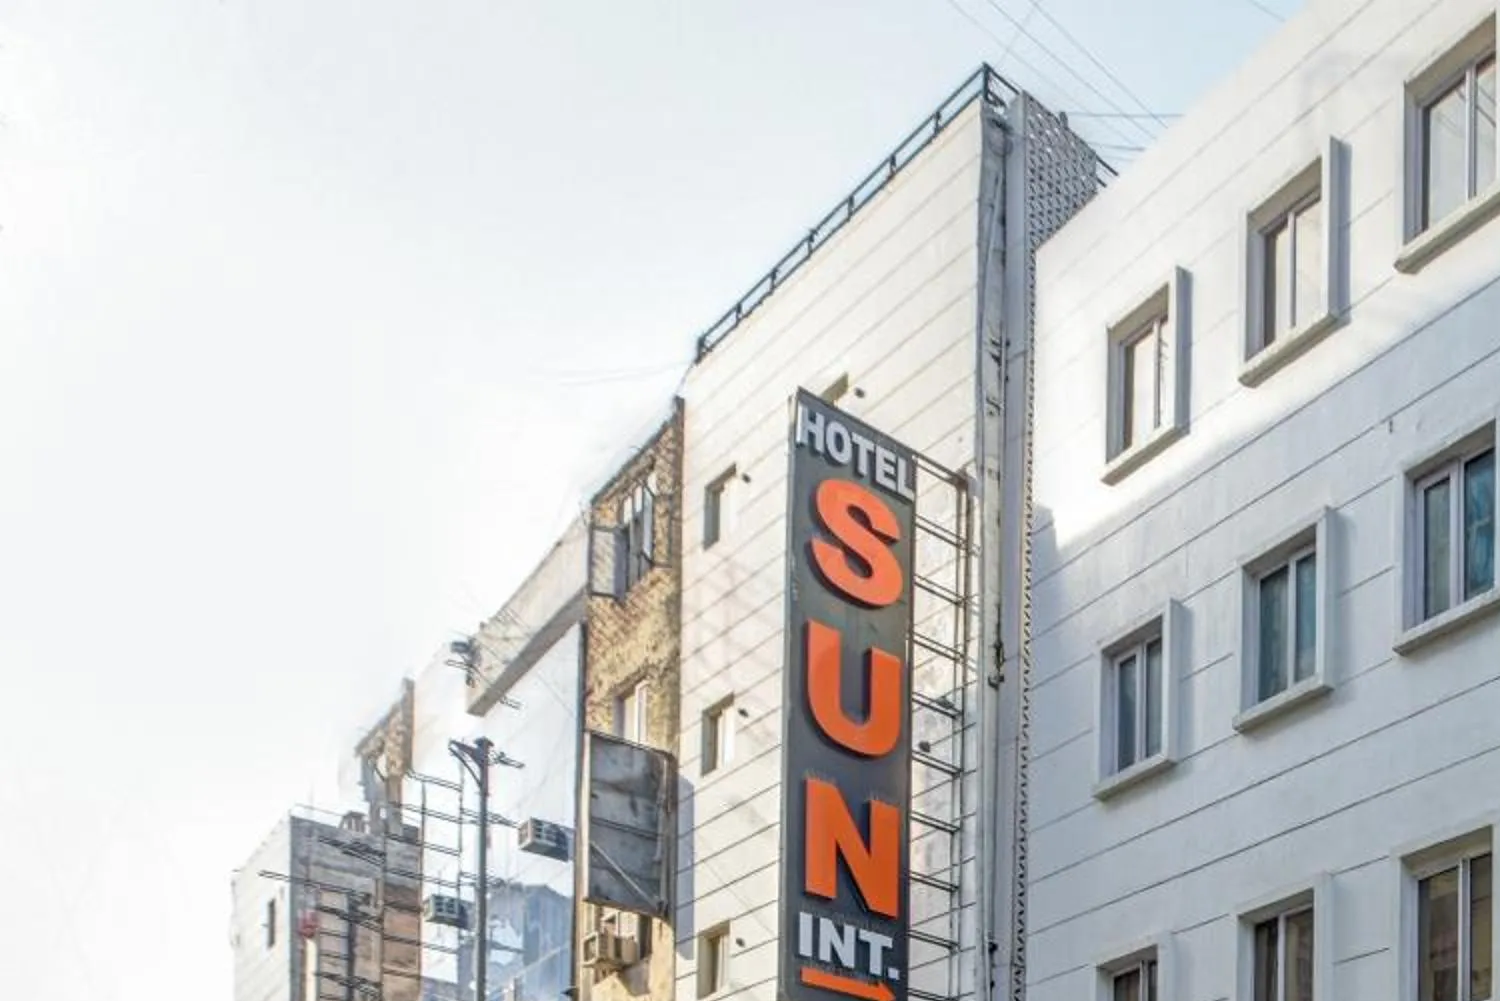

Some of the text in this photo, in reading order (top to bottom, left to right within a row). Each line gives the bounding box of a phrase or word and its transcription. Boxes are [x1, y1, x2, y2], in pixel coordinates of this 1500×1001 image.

[796, 404, 914, 499] HOTEL
[803, 478, 903, 917] SUN
[798, 911, 900, 981] INT.
